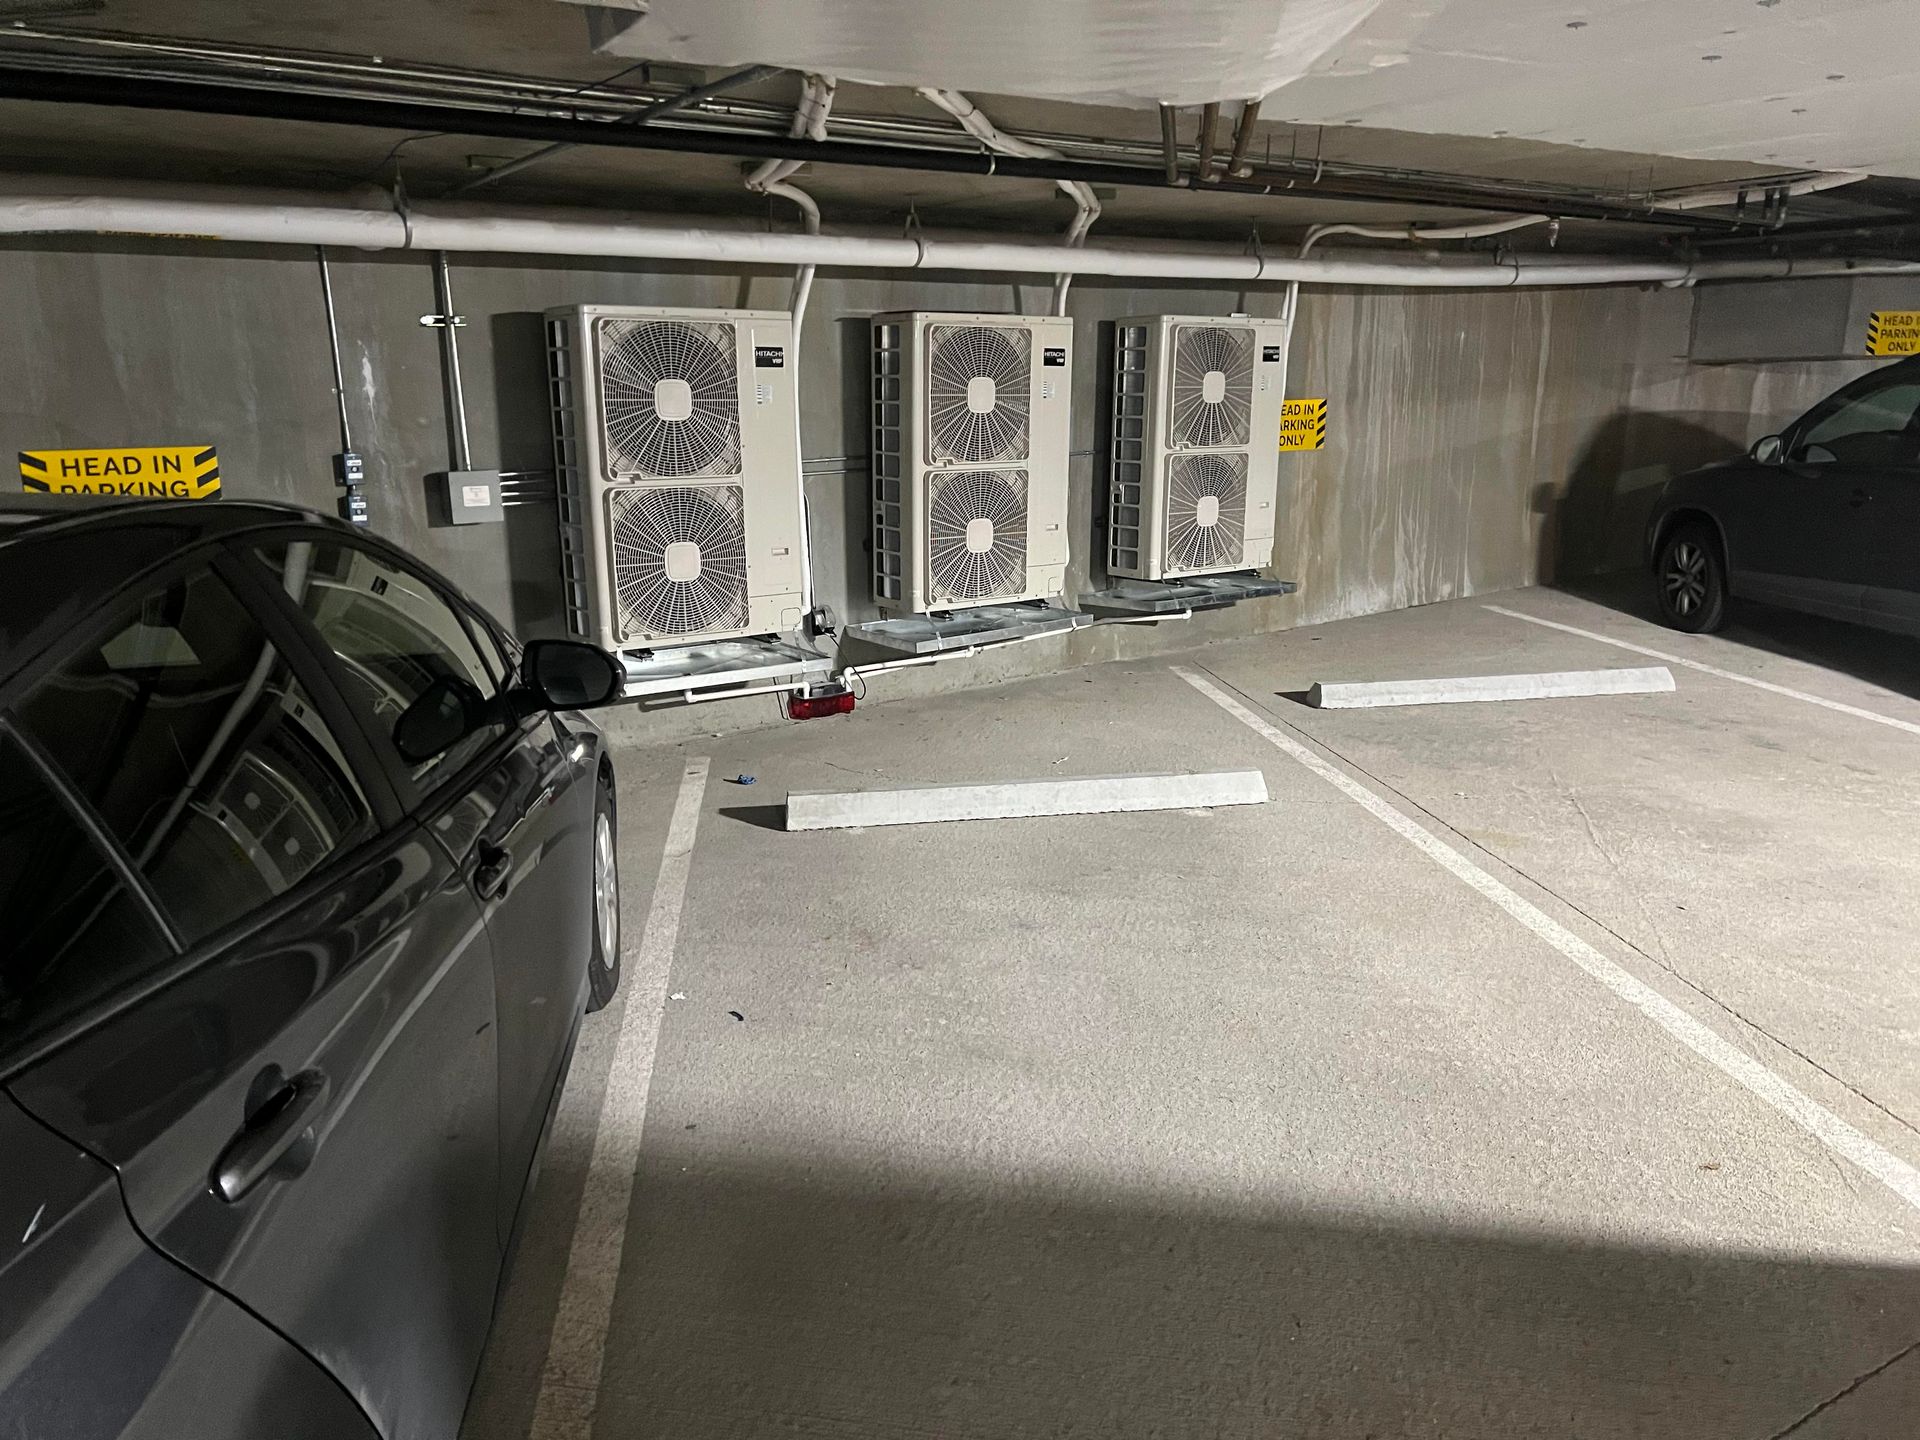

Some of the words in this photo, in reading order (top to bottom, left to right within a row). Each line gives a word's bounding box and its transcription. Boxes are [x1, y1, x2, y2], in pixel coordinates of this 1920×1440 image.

[1884, 315, 1913, 326] HEAD
[1880, 329, 1920, 339] PARKIN
[1888, 341, 1916, 352] ONLY
[755, 350, 783, 358] HITACHI
[1281, 404, 1300, 416] EAD
[1304, 404, 1314, 415] IN
[1280, 419, 1315, 430] RKING
[1279, 434, 1305, 446] ONLY
[60, 456, 142, 477] HEAD
[152, 454, 182, 474] IN
